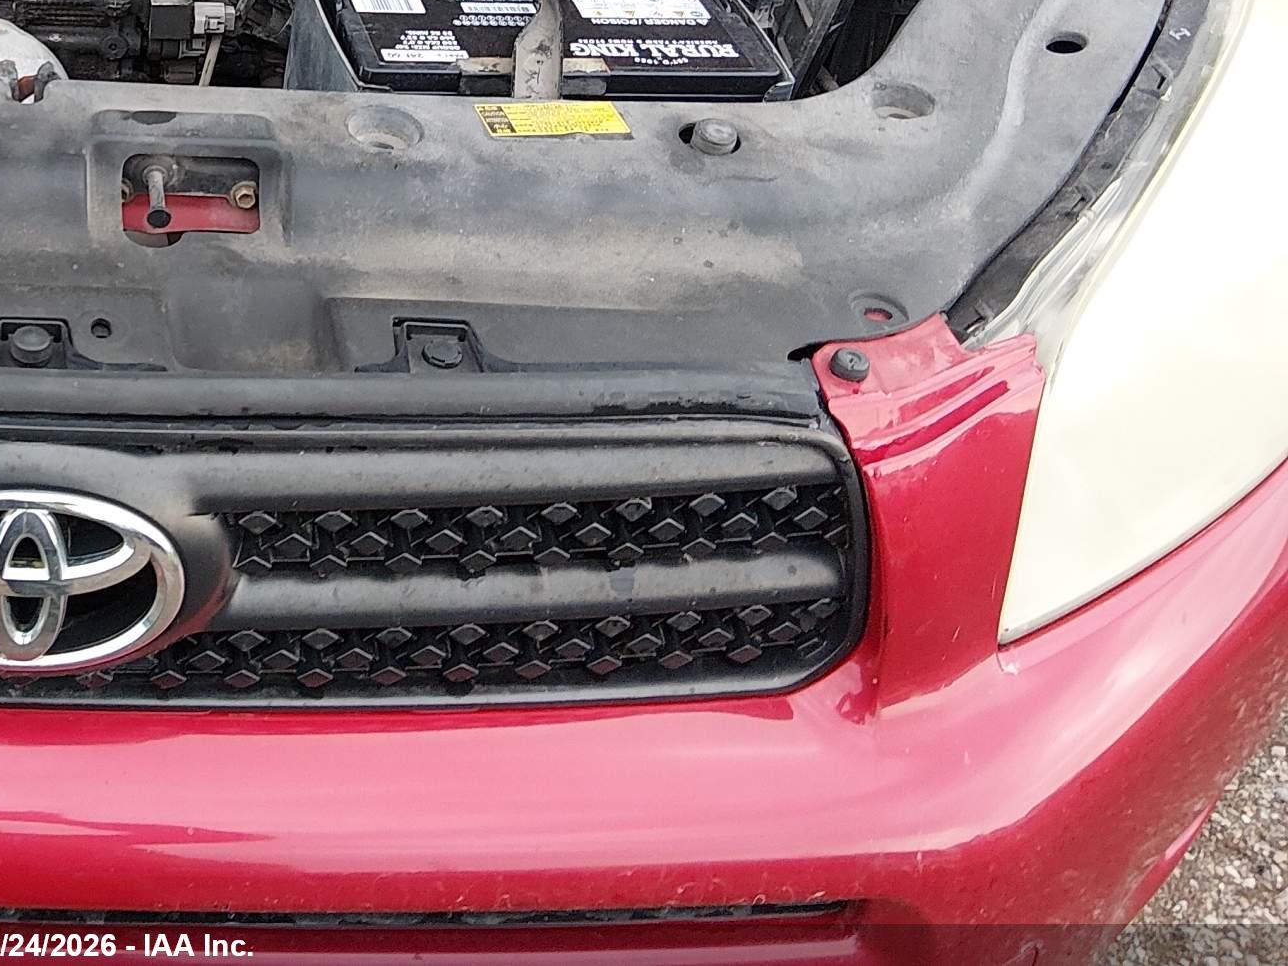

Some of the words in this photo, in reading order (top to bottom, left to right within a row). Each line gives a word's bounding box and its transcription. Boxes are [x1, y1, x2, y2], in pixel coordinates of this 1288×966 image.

[590, 17, 638, 25] POISON
[643, 18, 697, 26] DANGER
[569, 42, 640, 57] KING
[638, 43, 740, 58] RURAL
